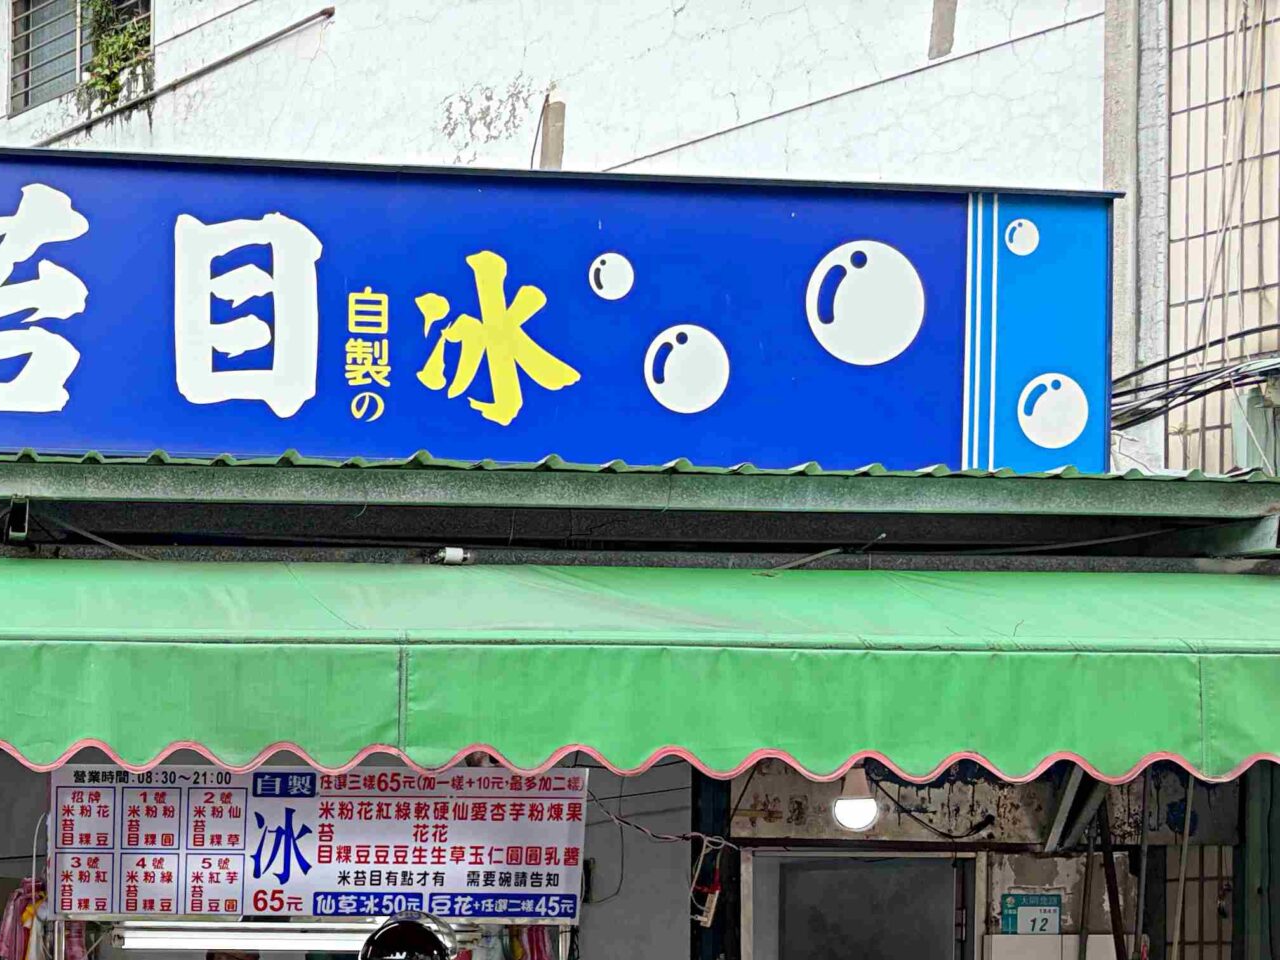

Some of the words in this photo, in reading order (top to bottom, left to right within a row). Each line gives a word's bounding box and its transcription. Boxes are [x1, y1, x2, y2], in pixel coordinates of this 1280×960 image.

[415, 250, 582, 426] 冰
[344, 287, 391, 423] 自製の
[256, 775, 312, 795] 自製
[71, 791, 101, 803] 招牌
[250, 807, 312, 885] 冰
[466, 871, 560, 888] 需要碗請告知
[253, 889, 303, 912] 65元
[1030, 917, 1049, 932] 12
